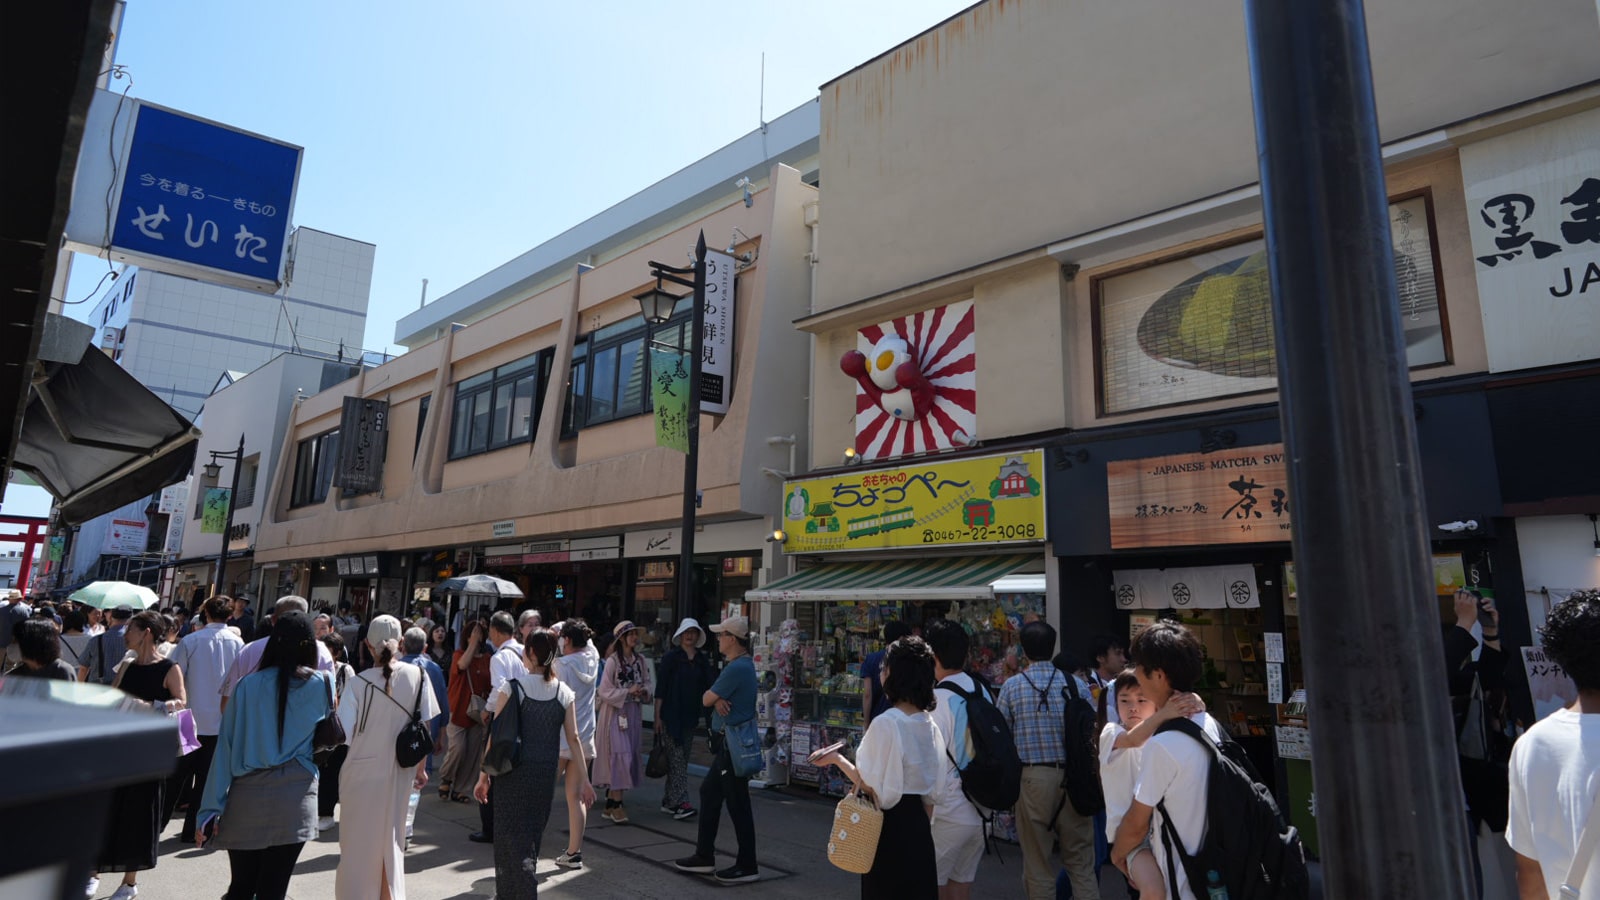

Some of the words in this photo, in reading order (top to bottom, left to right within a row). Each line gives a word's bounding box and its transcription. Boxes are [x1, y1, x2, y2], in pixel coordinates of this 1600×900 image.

[131, 202, 270, 264] せいた
[720, 263, 729, 302] UTSUWA
[702, 259, 718, 366] うつわ祥見
[719, 305, 728, 345] SHOKEN
[1210, 456, 1258, 470] MATCHA
[862, 472, 907, 488] おもちゃの
[1135, 501, 1208, 519] 抹茶スイーツ処
[934, 523, 1036, 541] 0467-22-3098
[1118, 585, 1135, 603] 茶
[1173, 584, 1189, 603] 茶
[1232, 582, 1249, 601] 茶
